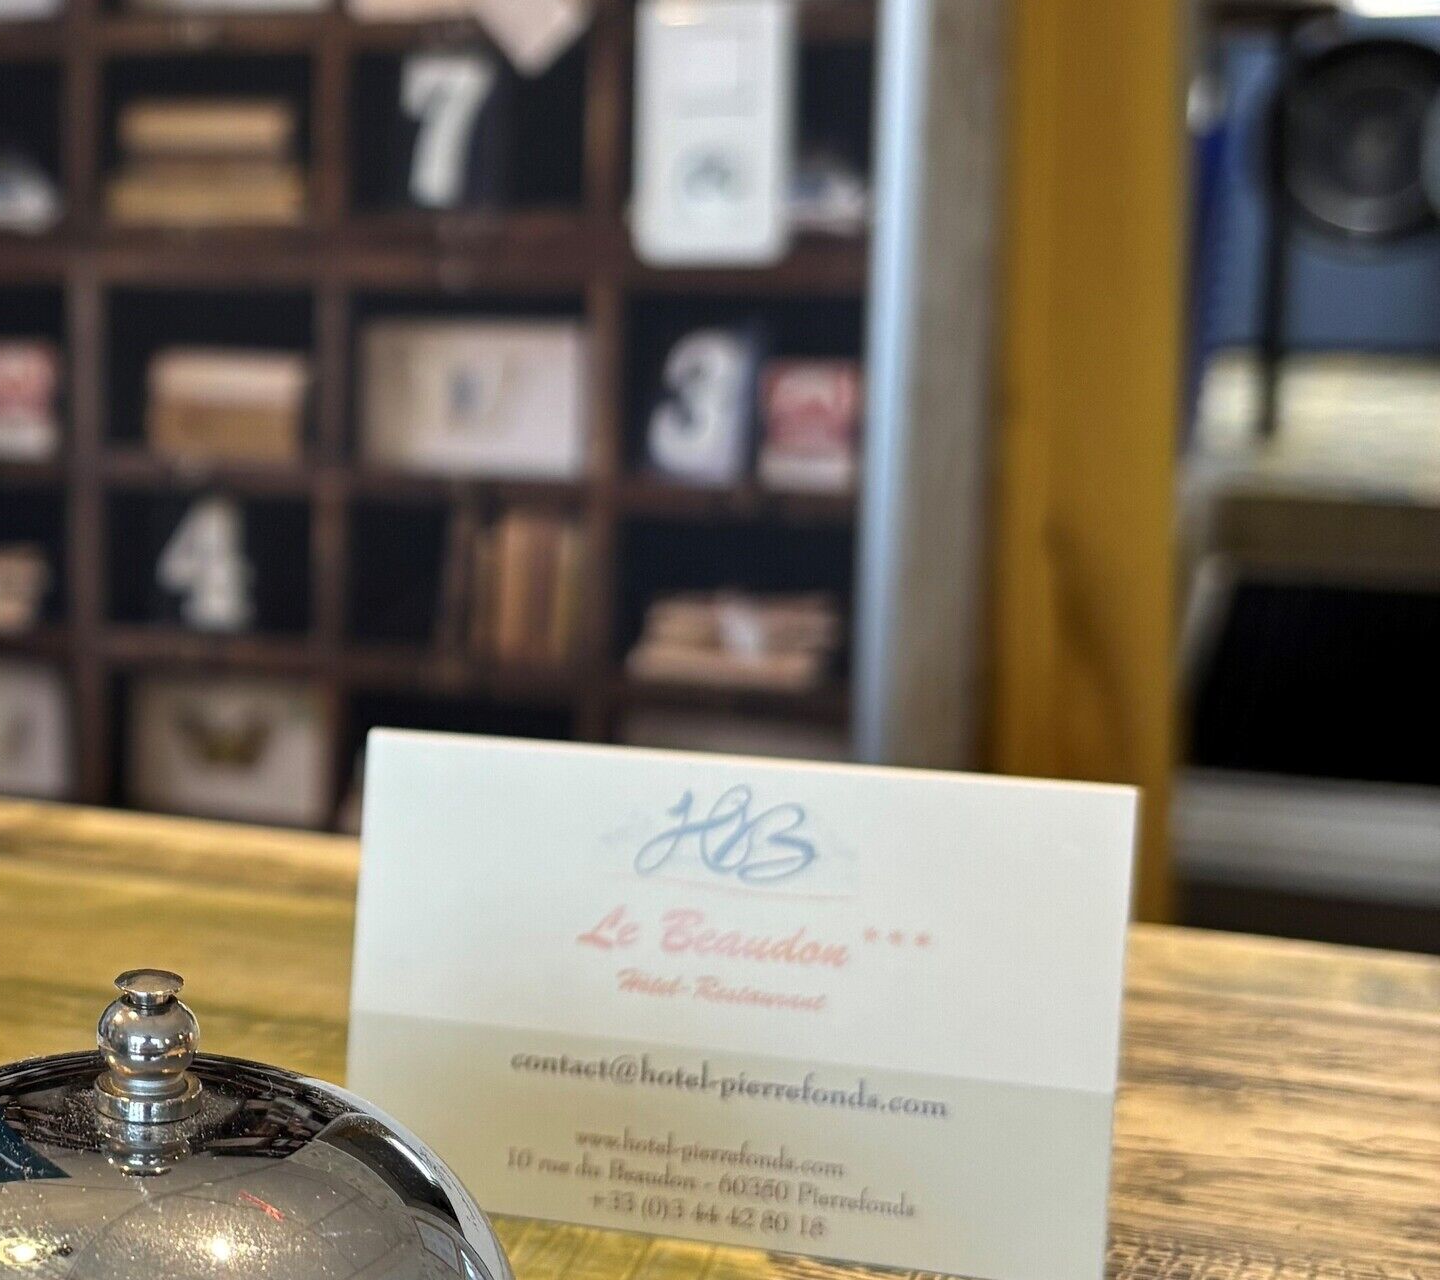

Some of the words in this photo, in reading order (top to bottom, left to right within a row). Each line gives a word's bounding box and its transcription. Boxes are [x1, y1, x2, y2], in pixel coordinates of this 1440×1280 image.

[575, 904, 640, 951] Le
[659, 908, 849, 969] Beaudon
[511, 1052, 948, 1119] contact@hotel-pierrefonds.com
[508, 1146, 533, 1172] 10
[538, 1158, 571, 1178] rue
[575, 1151, 602, 1180] du
[797, 1181, 916, 1220] Pierrefonds
[575, 1127, 846, 1179] www.hotel-pierrefonds.com
